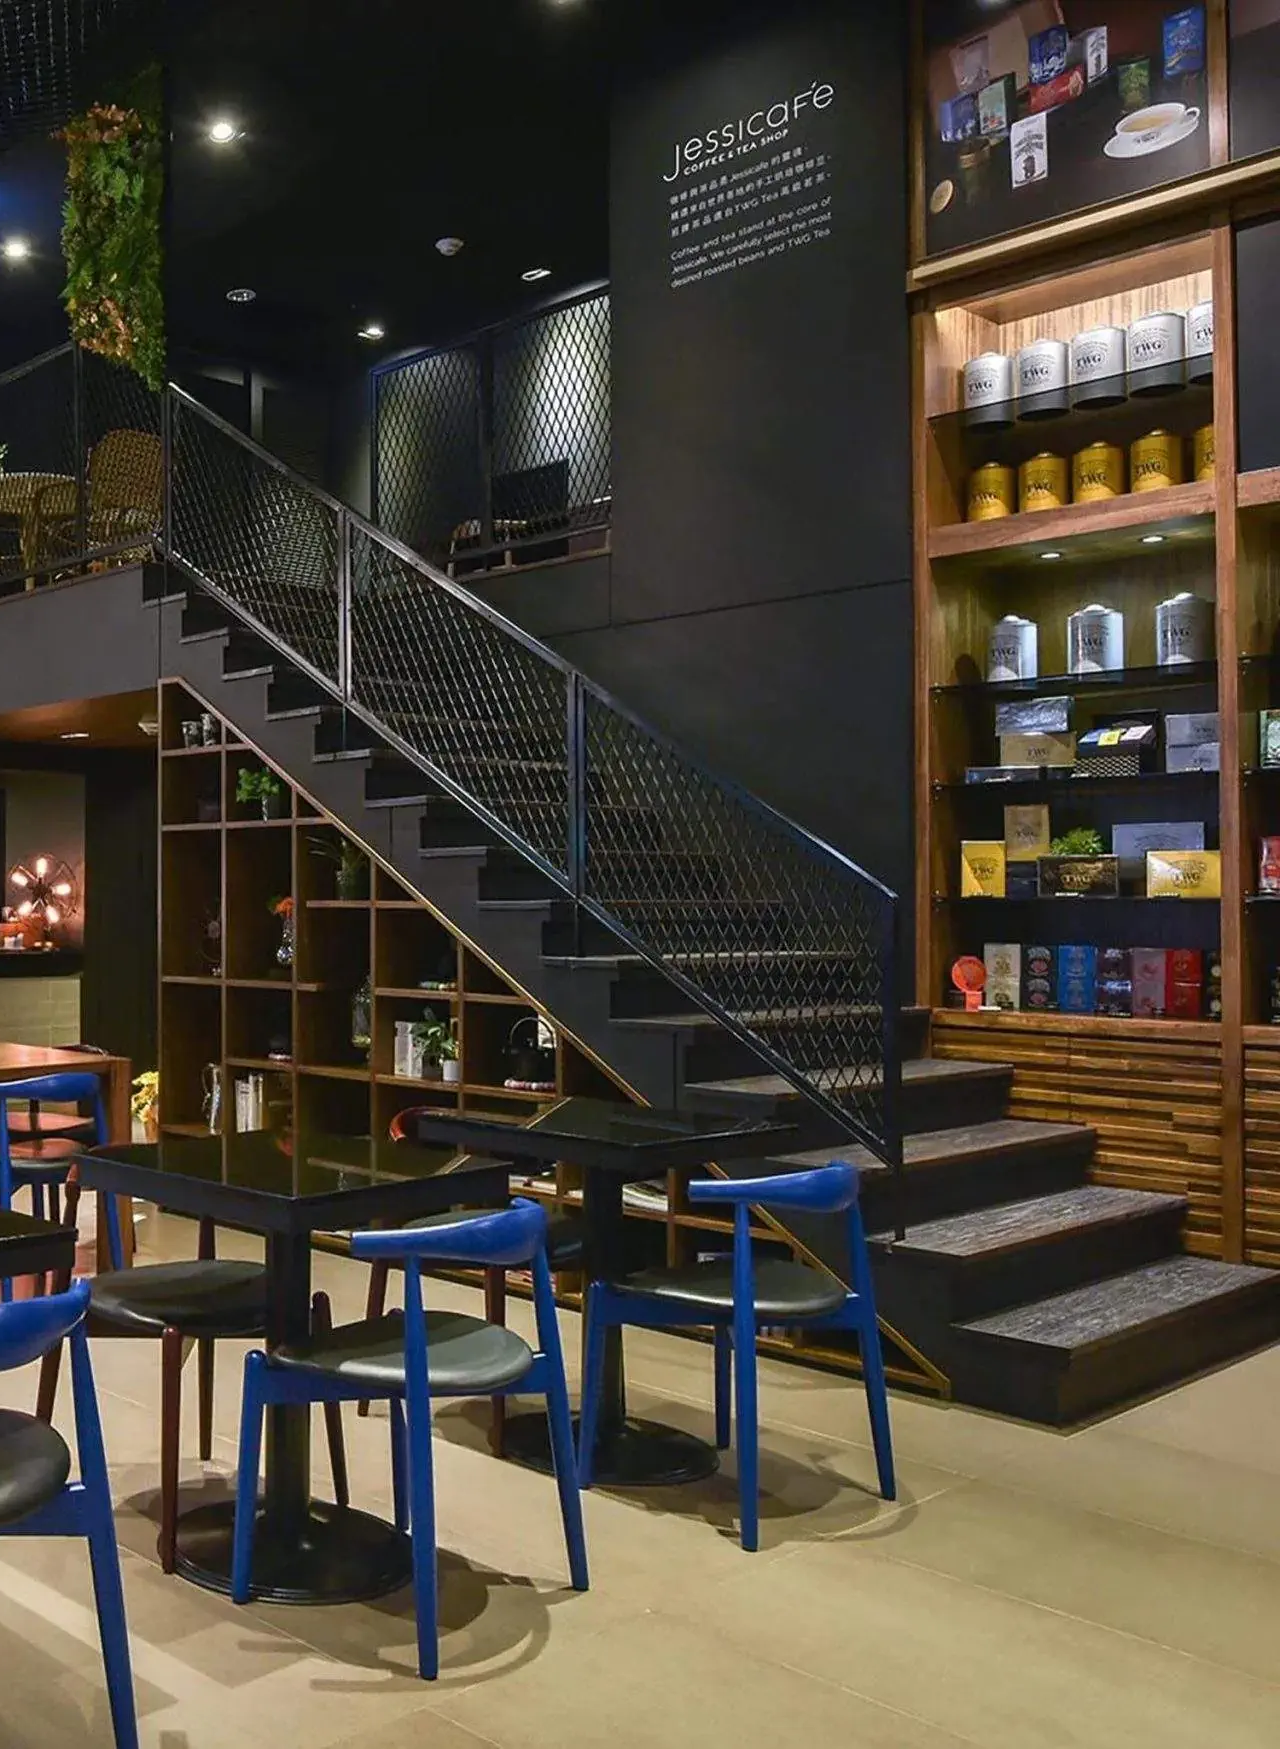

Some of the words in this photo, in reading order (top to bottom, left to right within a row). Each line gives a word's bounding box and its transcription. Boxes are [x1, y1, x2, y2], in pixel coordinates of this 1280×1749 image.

[683, 152, 726, 176] COFFEE
[736, 141, 758, 156] TEA
[760, 129, 789, 146] SHOP
[734, 198, 759, 213] TWG
[761, 192, 779, 204] Tea
[671, 245, 701, 261] Coffee
[702, 237, 720, 249] and
[721, 231, 737, 243] tea
[738, 221, 765, 236] stand
[766, 216, 776, 227] at
[777, 211, 794, 223] the
[795, 202, 819, 216] core
[820, 195, 832, 208] of
[726, 238, 762, 255] carefully
[763, 226, 790, 242] select
[791, 220, 807, 232] the
[808, 211, 832, 226] most
[671, 271, 703, 288] desired
[703, 259, 737, 276] roasted
[738, 251, 766, 265] beans
[768, 243, 785, 255] and
[788, 233, 811, 247] TWG
[813, 228, 831, 238] Tea
[1134, 340, 1162, 355] TWG
[1075, 354, 1101, 367] TWG
[1023, 366, 1049, 379] TWG
[967, 380, 993, 393] TWG
